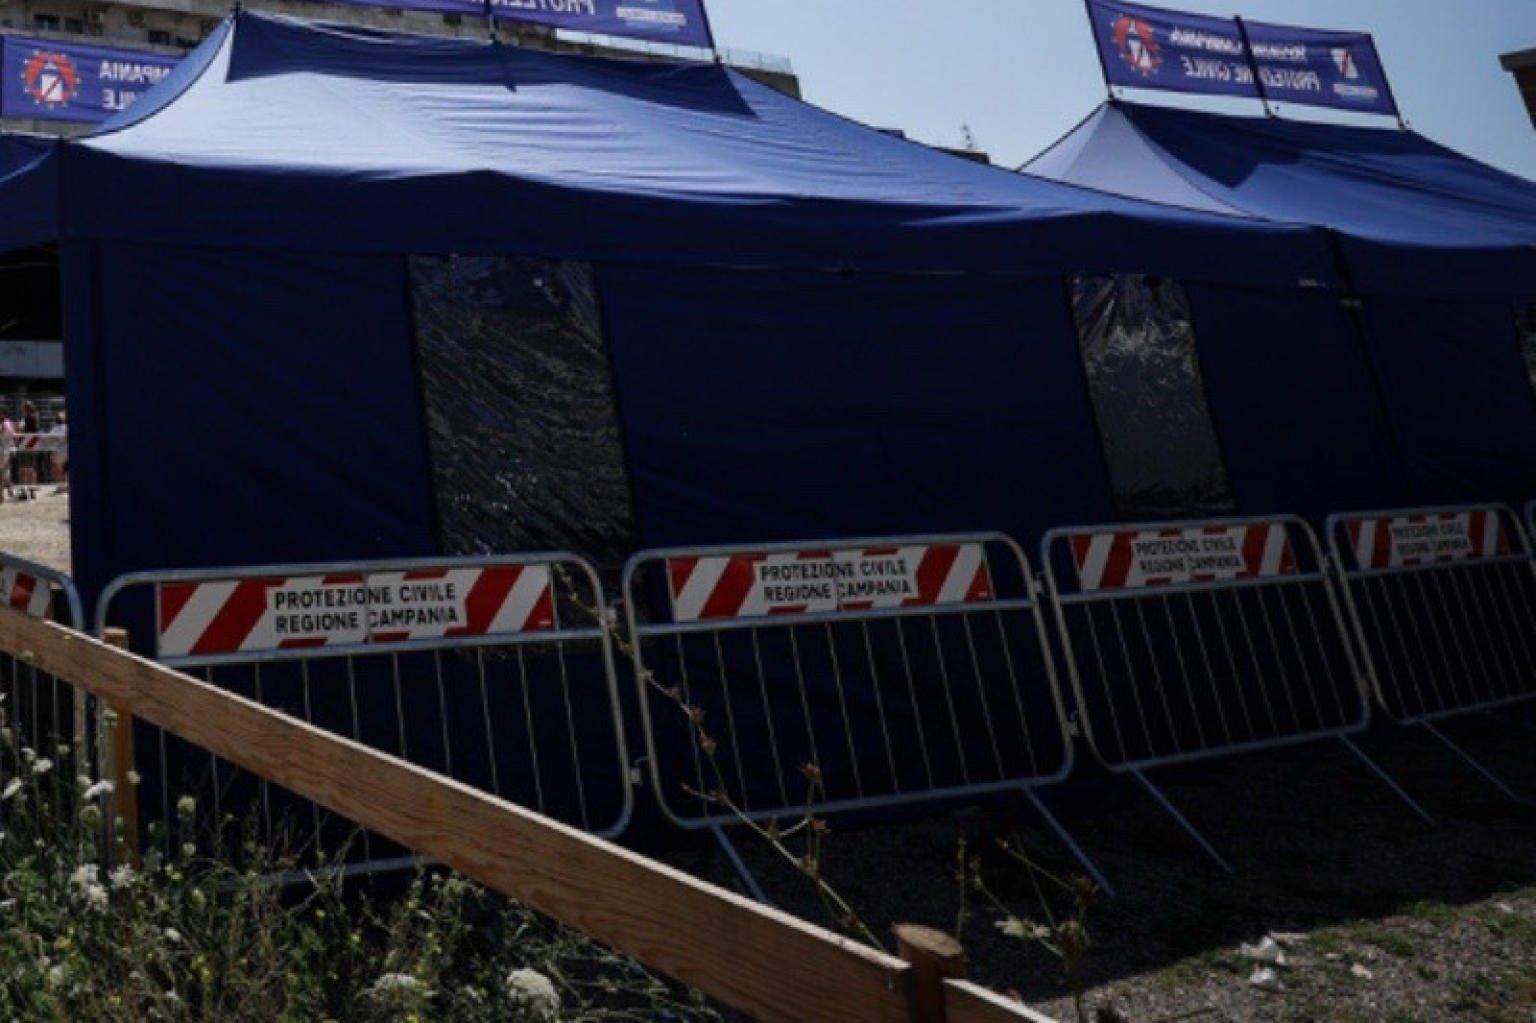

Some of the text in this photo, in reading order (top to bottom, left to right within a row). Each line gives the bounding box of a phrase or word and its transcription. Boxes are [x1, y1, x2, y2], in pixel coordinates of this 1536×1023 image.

[762, 560, 906, 581] PROTEZIONE CIVILE
[275, 583, 456, 610] PROTEZIONE CIVILE
[764, 580, 911, 601] REGIONE CAMPANIA
[275, 606, 458, 633] REGIONE CAMPANIA
